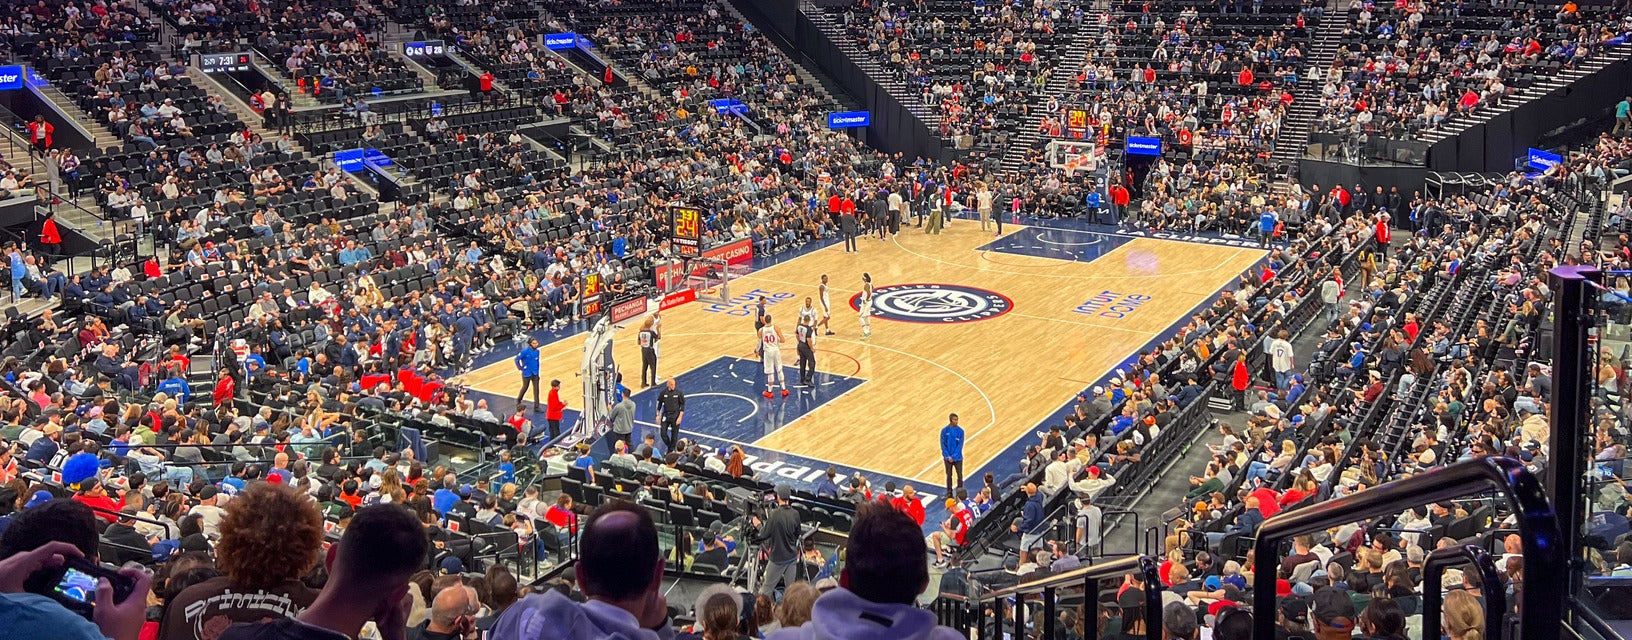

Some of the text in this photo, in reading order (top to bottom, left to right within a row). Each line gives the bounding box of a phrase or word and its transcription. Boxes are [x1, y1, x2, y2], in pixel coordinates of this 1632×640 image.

[832, 116, 865, 124] ticketmaster
[676, 218, 696, 237] 24
[1153, 232, 1267, 248] CLIPPER
[725, 245, 750, 260] CASINO
[943, 295, 1005, 322] CLIPPERS
[764, 334, 775, 343] 40
